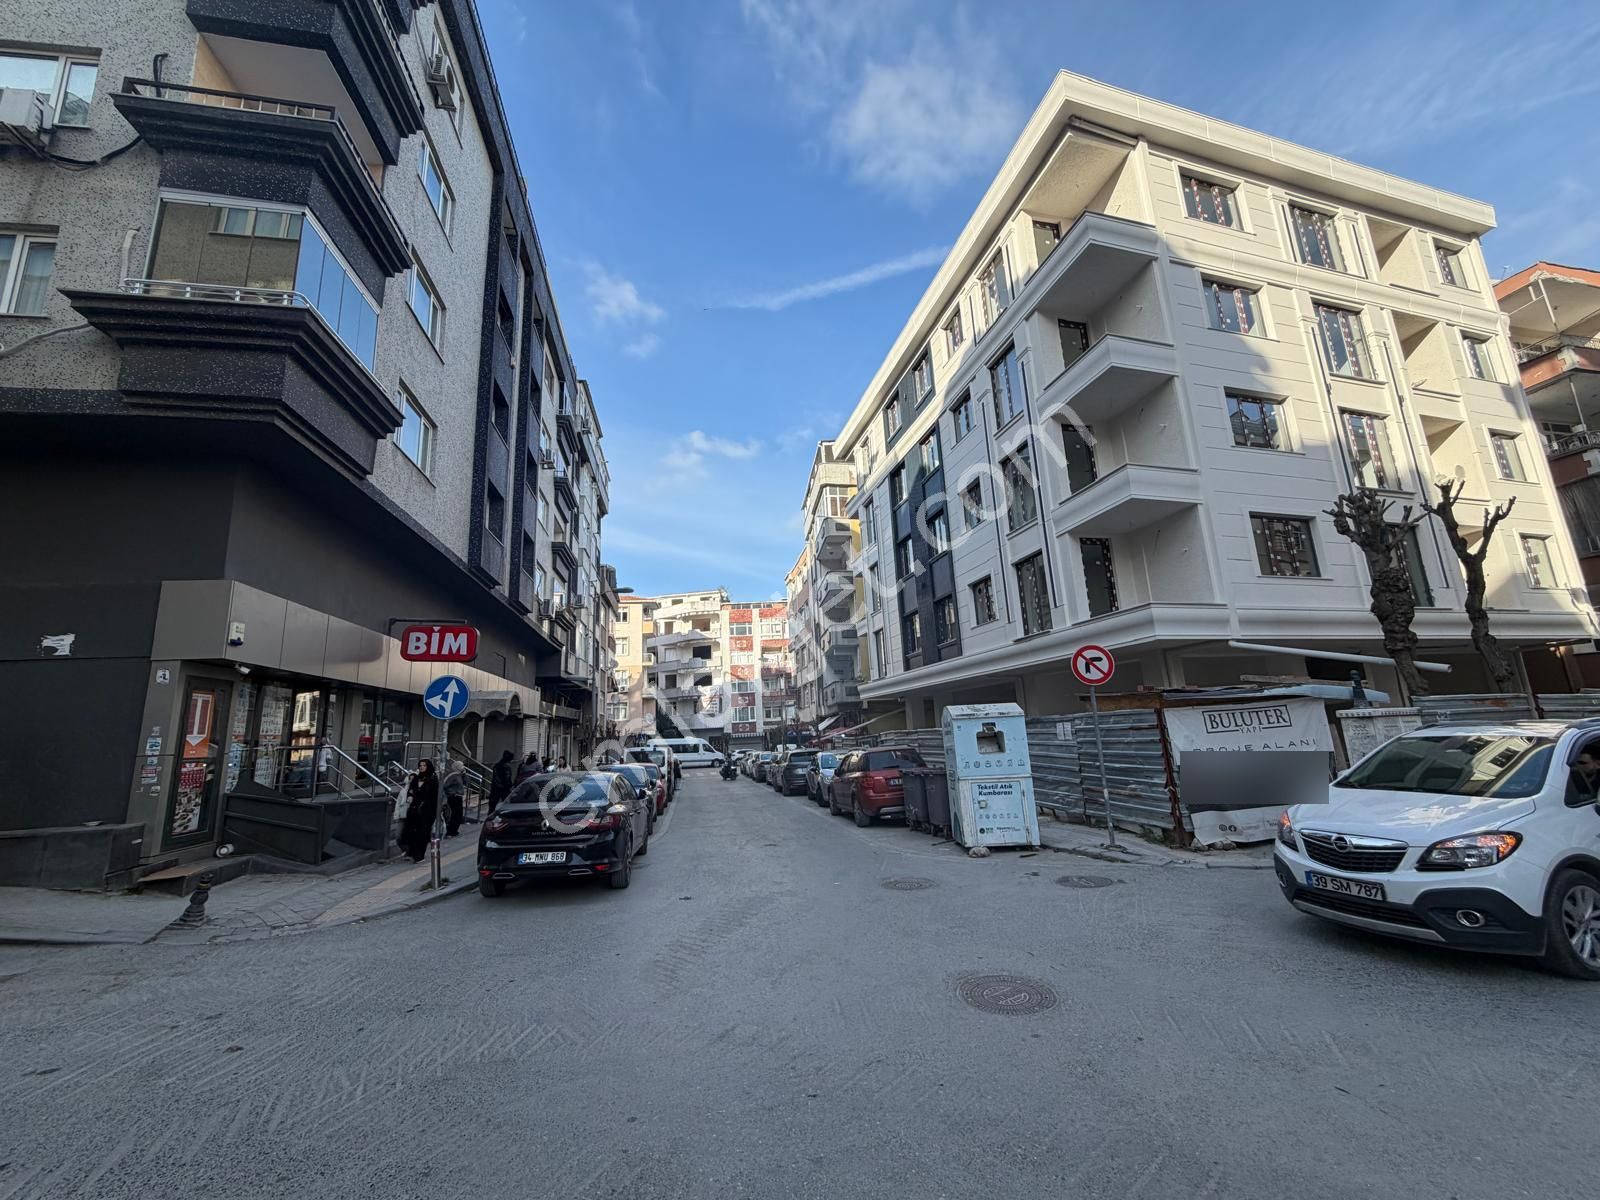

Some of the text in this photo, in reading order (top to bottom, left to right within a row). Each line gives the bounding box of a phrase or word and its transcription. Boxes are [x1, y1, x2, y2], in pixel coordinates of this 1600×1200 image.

[407, 626, 468, 655] BİM
[1207, 708, 1288, 729] BULUTER
[1240, 726, 1263, 734] YAPI
[1262, 738, 1317, 750] ALANI
[1312, 874, 1379, 898] 39 SM 787
